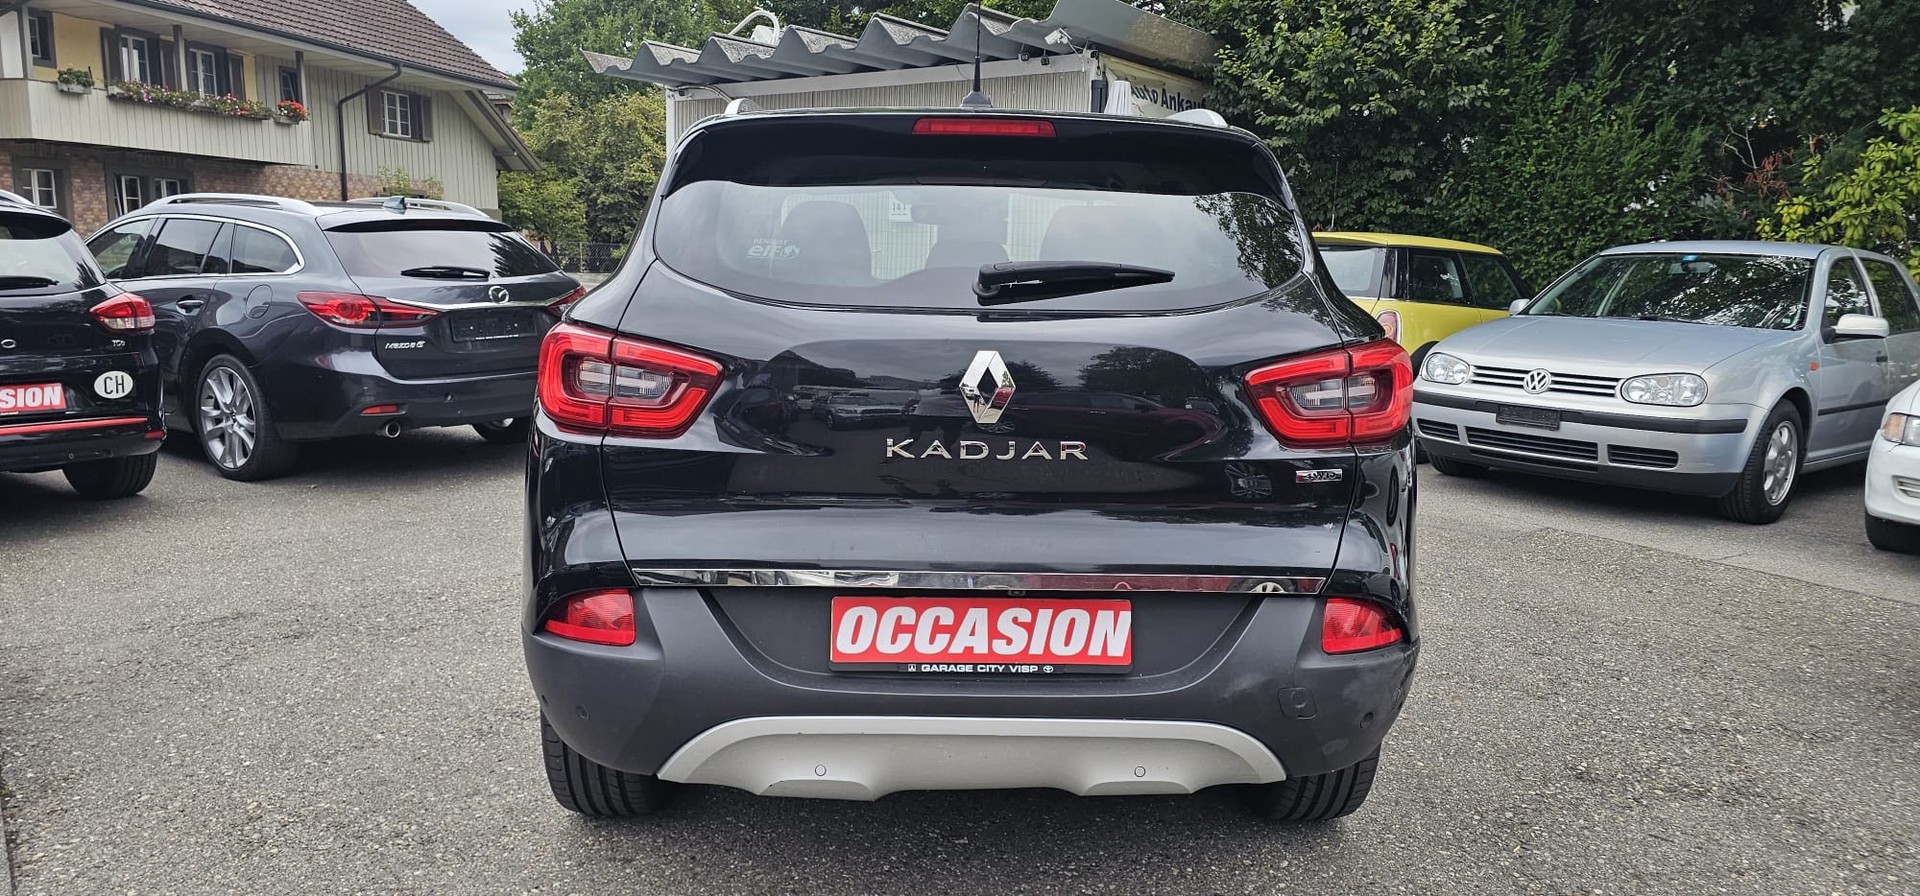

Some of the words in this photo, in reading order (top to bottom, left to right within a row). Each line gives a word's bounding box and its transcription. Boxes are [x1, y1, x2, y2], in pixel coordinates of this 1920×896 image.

[1131, 84, 1159, 104] Auto
[103, 375, 125, 395] CH
[0, 386, 61, 408] SION
[885, 438, 1089, 461] KADJAR
[836, 606, 1132, 657] OCCASION
[921, 664, 974, 673] GARAGE
[977, 664, 1005, 673] CITY
[1008, 664, 1039, 673] VISP
